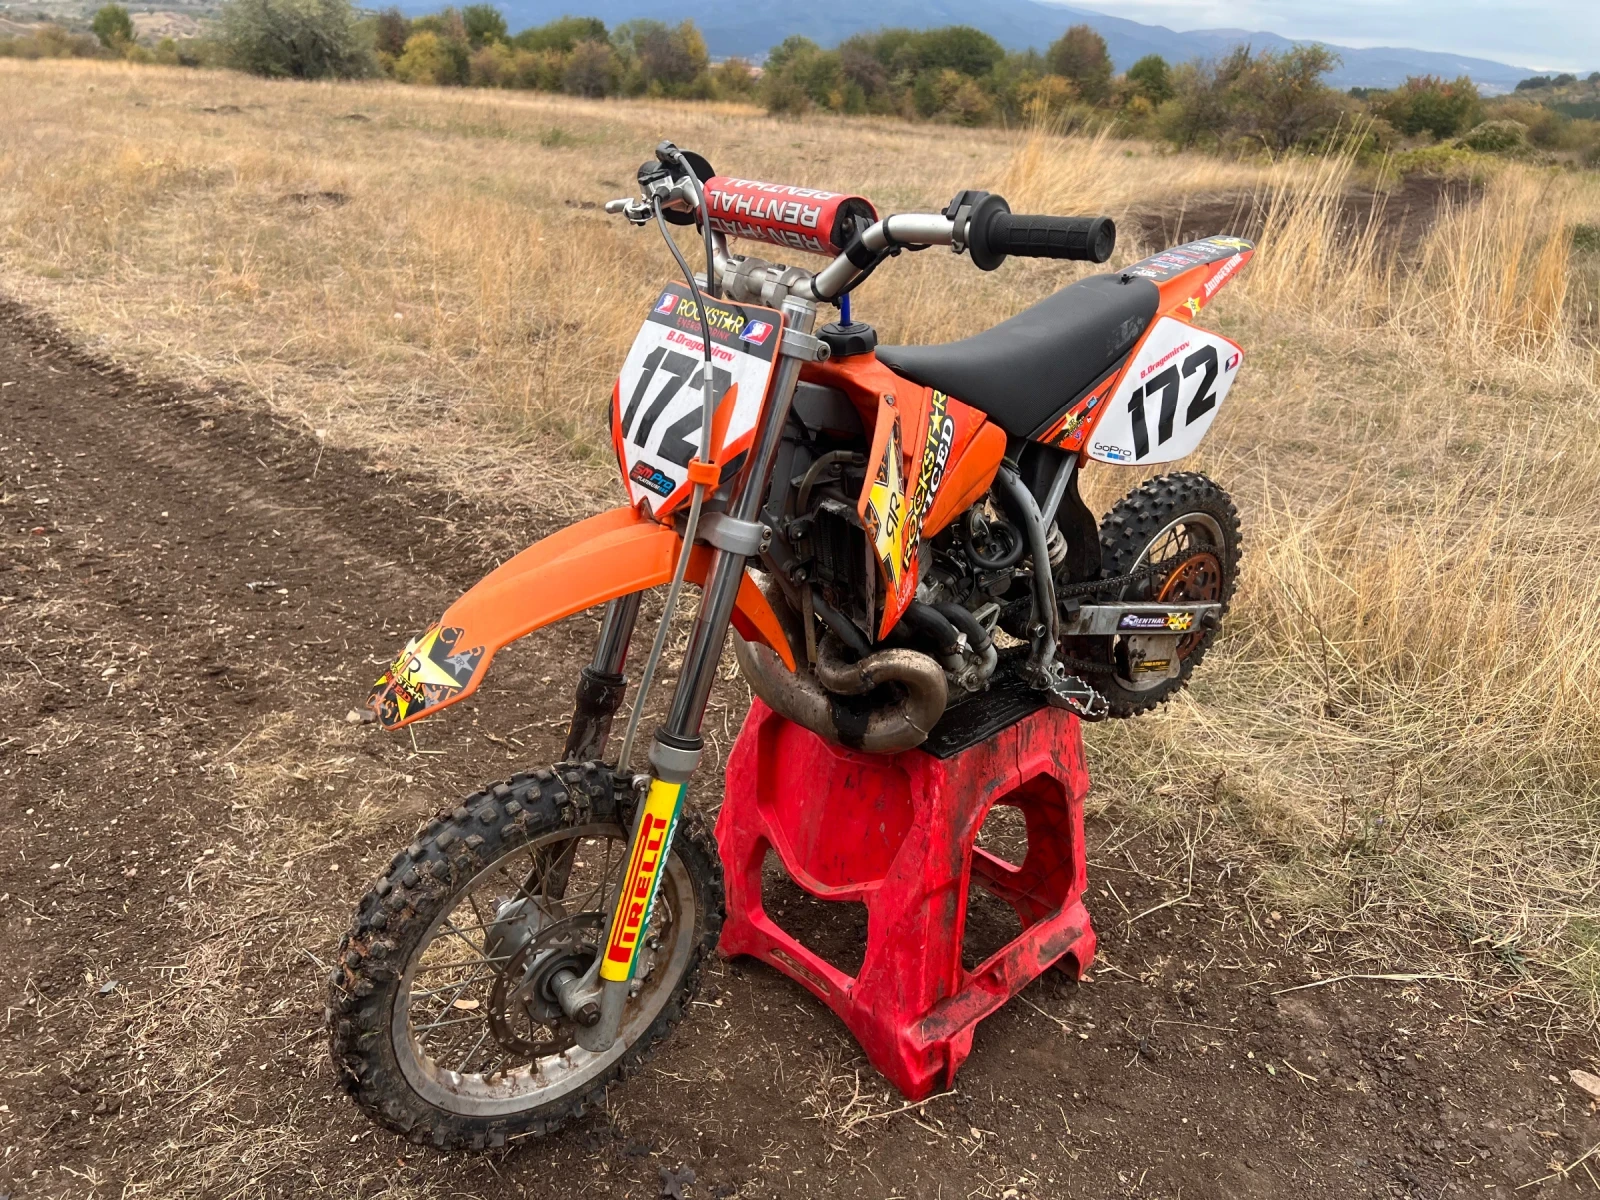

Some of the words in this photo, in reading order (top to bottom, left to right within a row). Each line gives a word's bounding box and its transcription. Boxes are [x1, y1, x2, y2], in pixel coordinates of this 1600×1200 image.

[724, 177, 845, 201] RENTHAL
[709, 190, 822, 229] RENTHAL
[709, 217, 825, 252] RENTHAL
[677, 317, 703, 332] ENERG
[666, 330, 736, 362] B.Dragoirov
[1140, 341, 1190, 379] B.Dragomirov
[621, 346, 731, 470] 172
[1127, 344, 1219, 462] 172
[1094, 442, 1132, 457] GoPro
[1132, 617, 1165, 625] RENTHAL
[607, 813, 667, 963] PIRELLI
